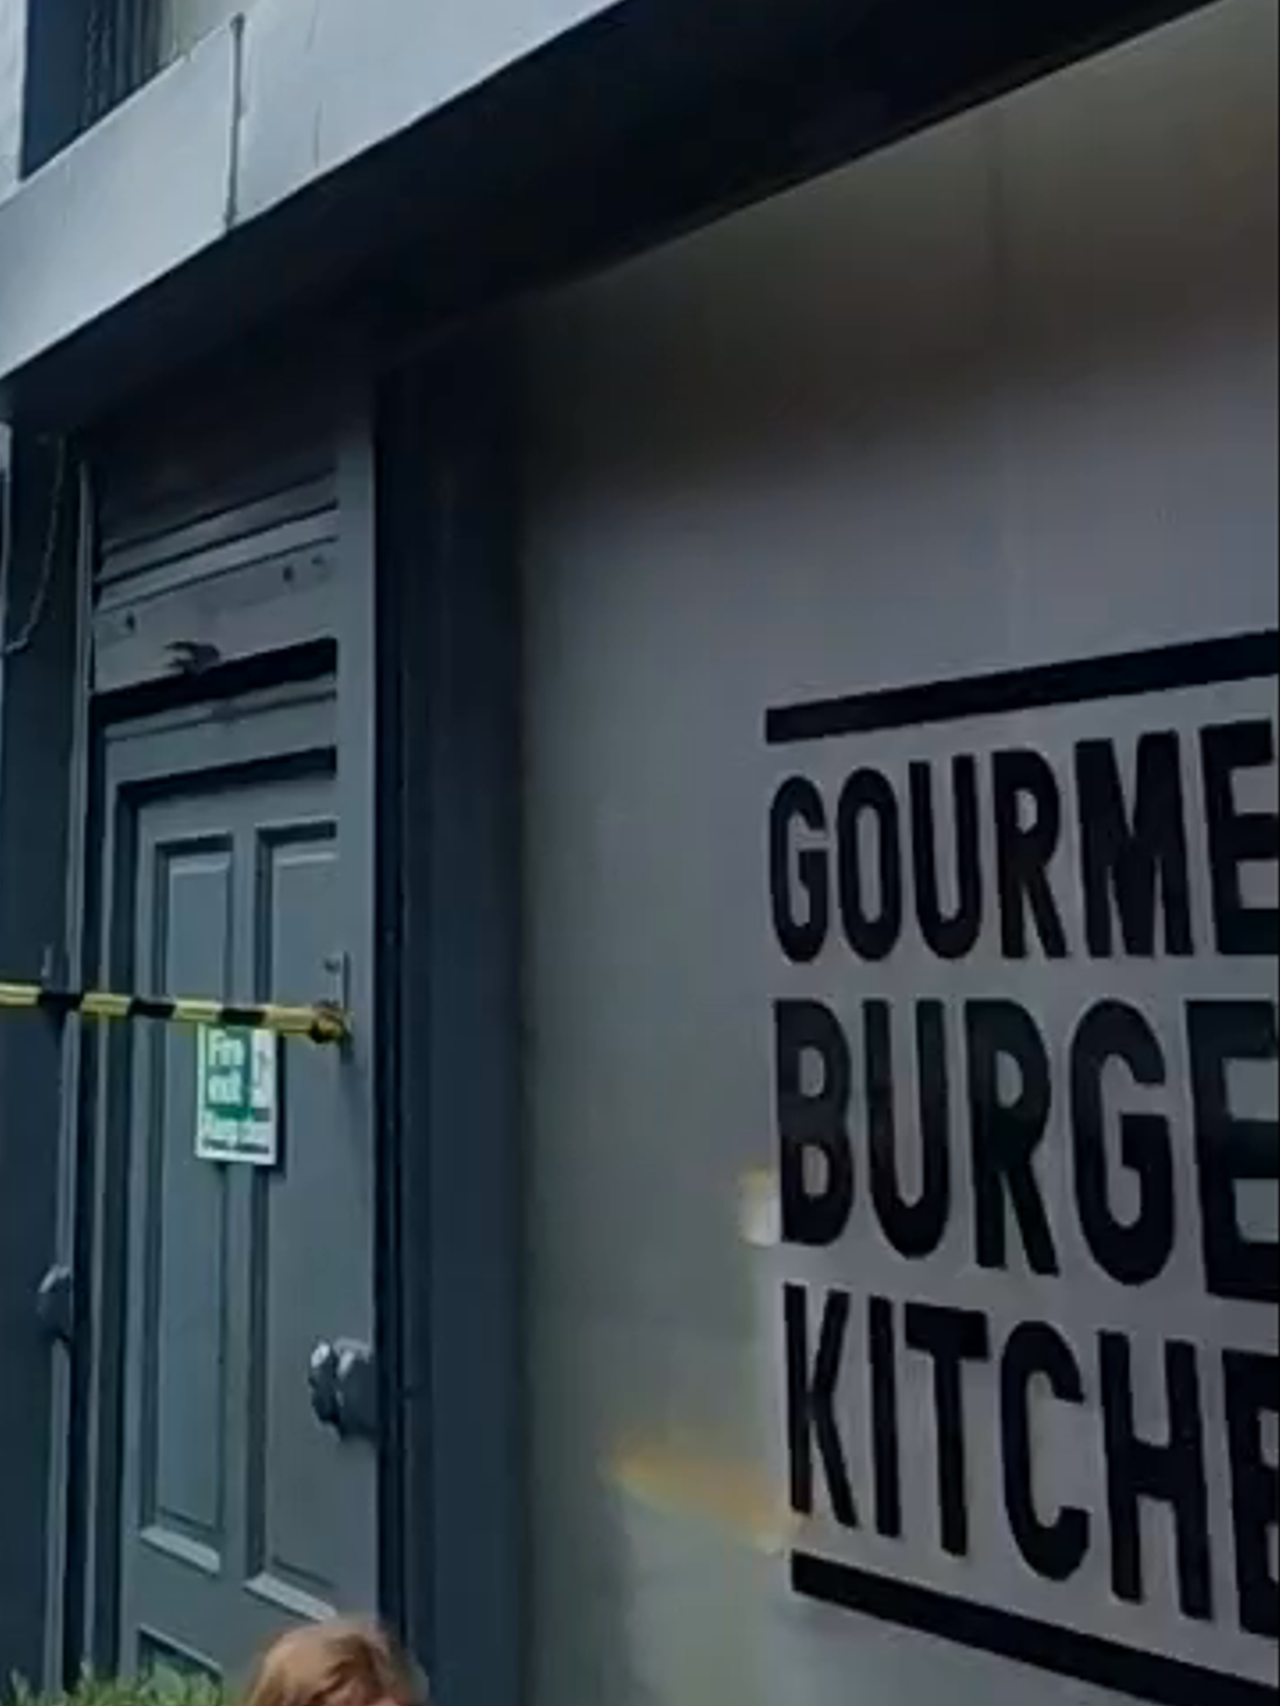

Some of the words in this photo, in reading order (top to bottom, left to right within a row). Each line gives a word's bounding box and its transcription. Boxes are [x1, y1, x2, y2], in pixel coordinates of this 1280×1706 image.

[768, 719, 1278, 964] GOURME
[774, 997, 1280, 1302] BURGE
[782, 1280, 1280, 1637] KITCHE
